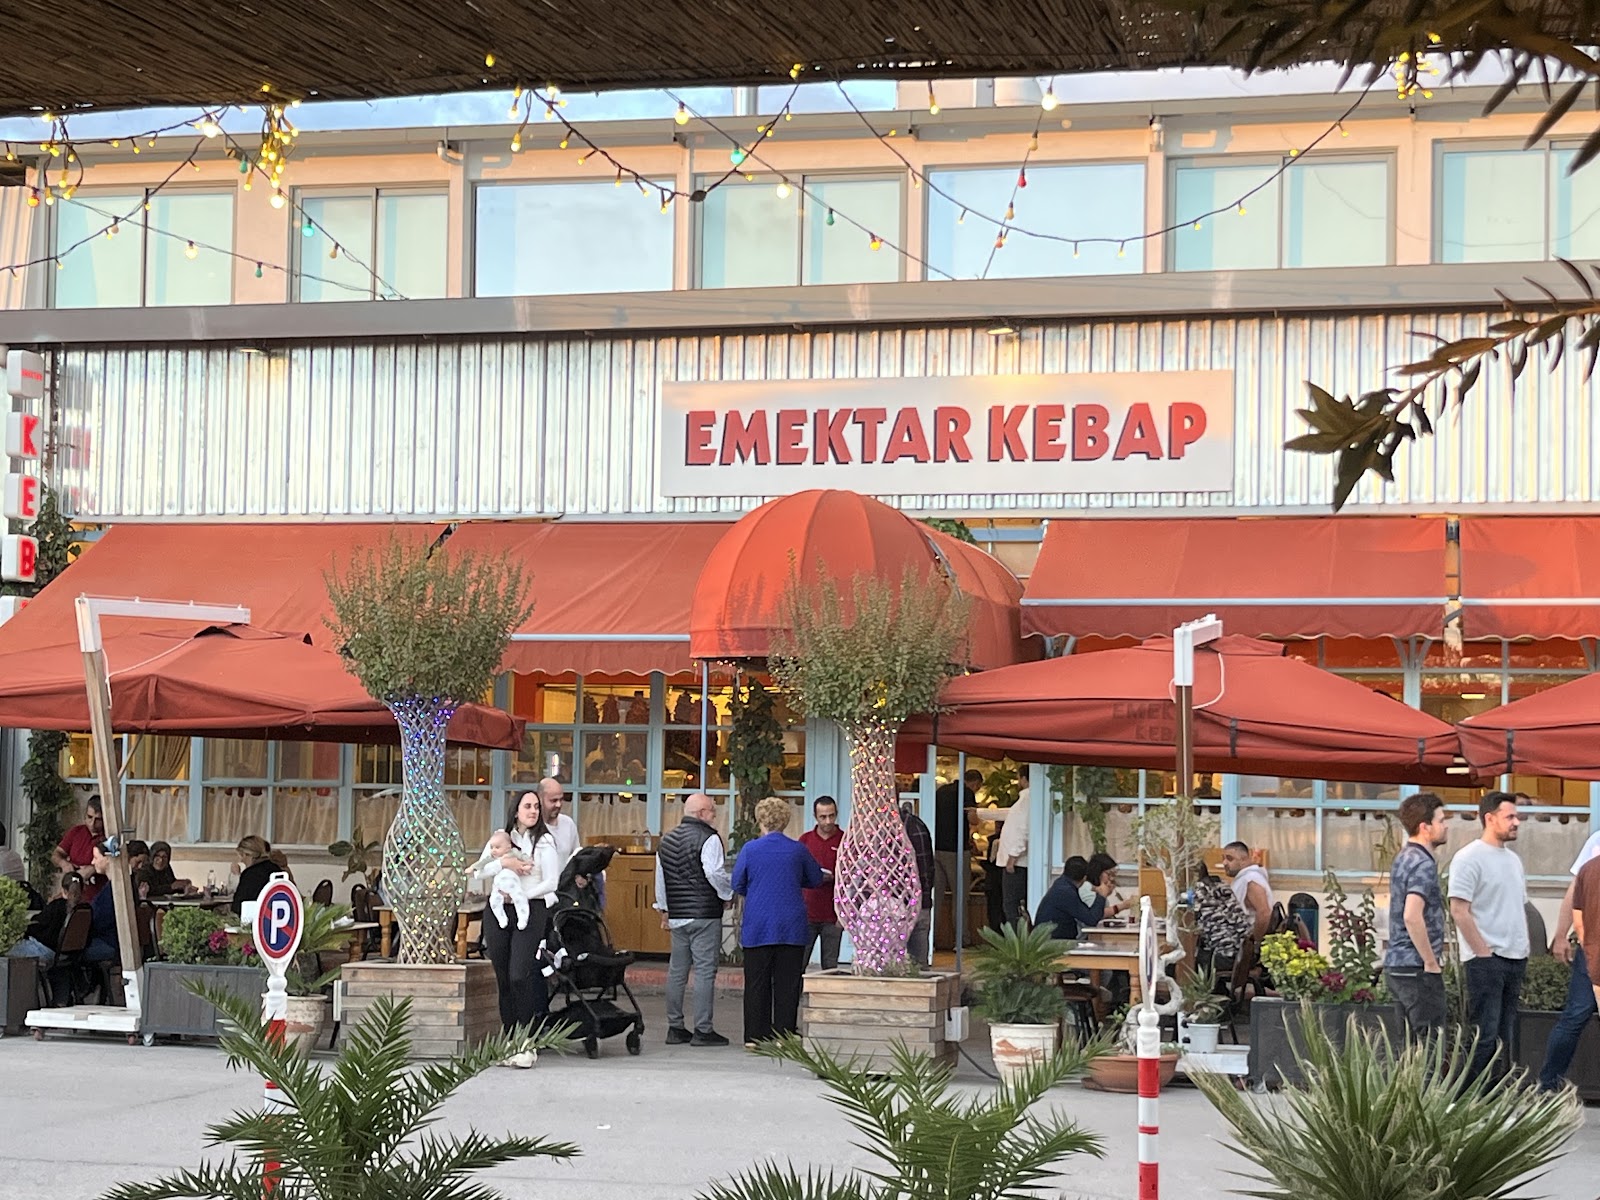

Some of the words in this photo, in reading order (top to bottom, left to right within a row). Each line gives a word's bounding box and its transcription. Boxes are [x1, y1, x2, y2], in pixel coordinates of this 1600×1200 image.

[684, 407, 973, 466] EMEKTAR
[987, 402, 1208, 462] KEBAP
[20, 415, 38, 609] KEB
[270, 900, 291, 945] P
